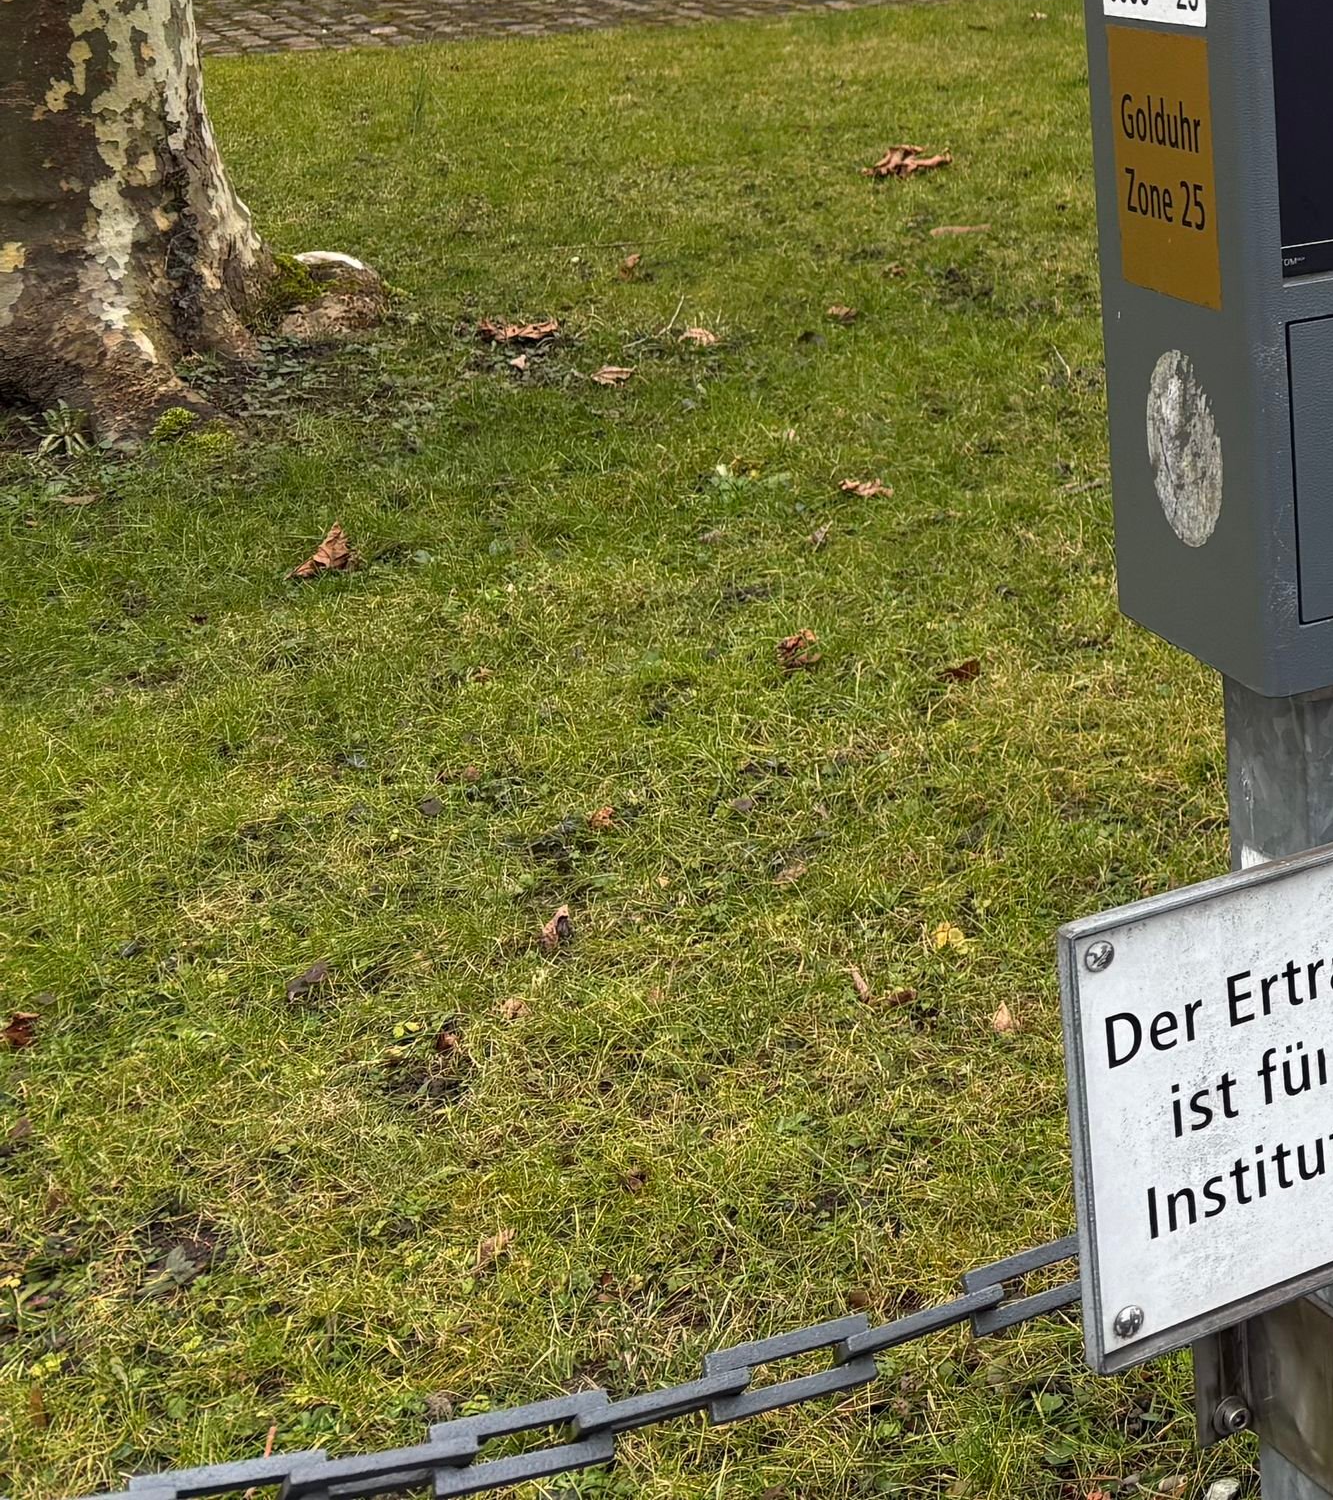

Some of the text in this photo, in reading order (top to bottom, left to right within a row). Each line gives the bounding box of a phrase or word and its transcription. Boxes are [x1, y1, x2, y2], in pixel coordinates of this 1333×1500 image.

[1121, 94, 1201, 153] Golduhr
[1125, 167, 1205, 231] Zone 25
[1105, 999, 1202, 1069] Der
[1171, 1071, 1239, 1138] ist
